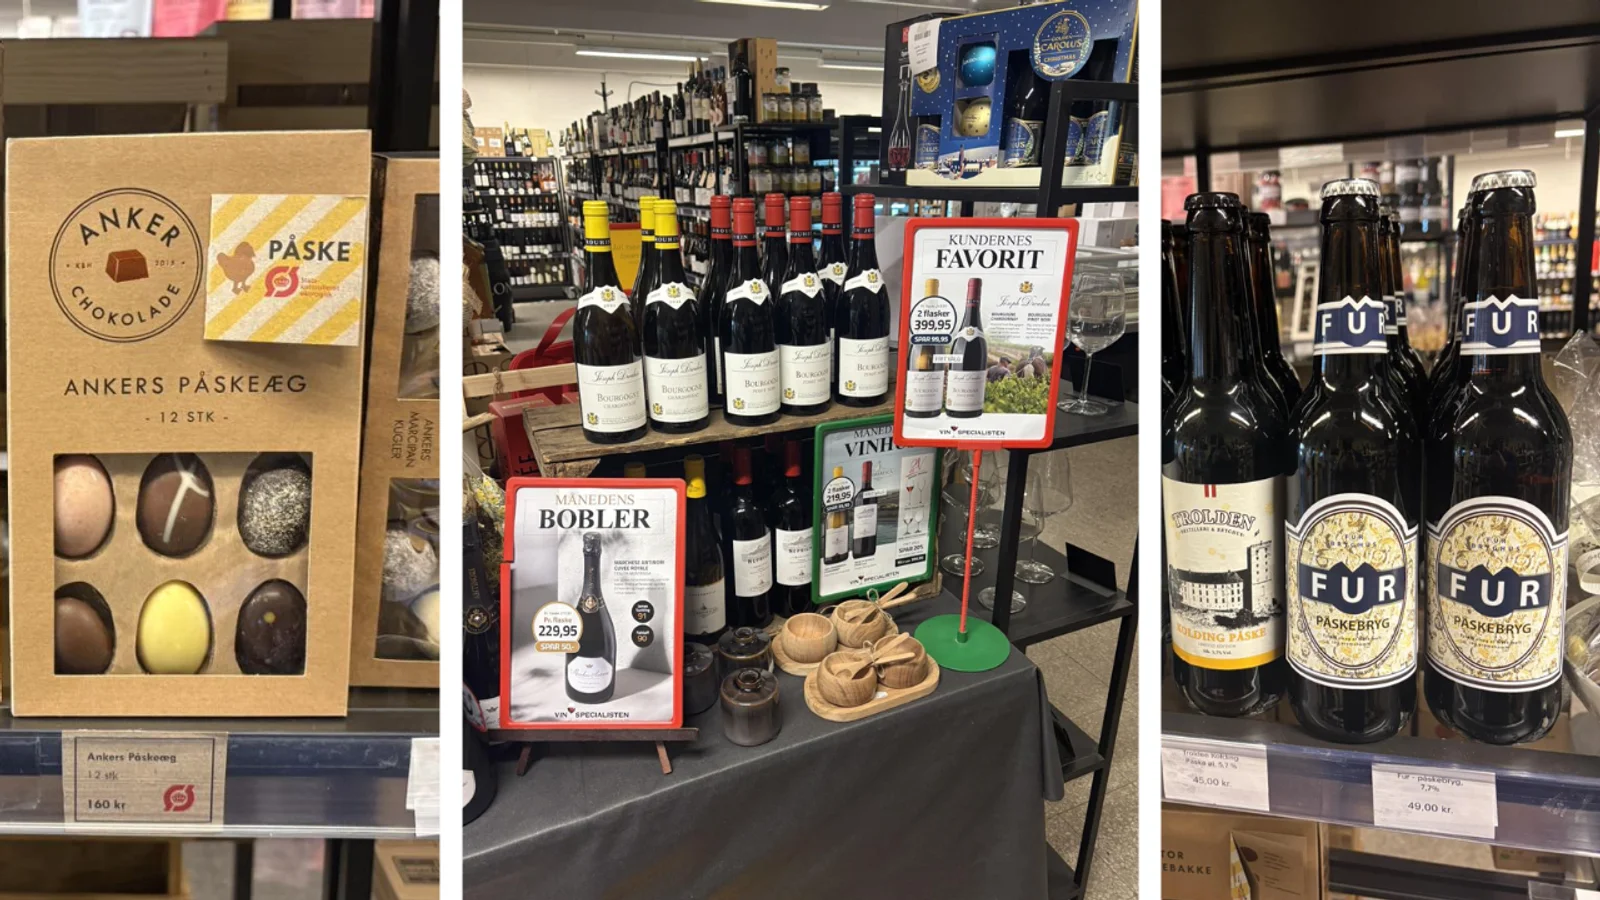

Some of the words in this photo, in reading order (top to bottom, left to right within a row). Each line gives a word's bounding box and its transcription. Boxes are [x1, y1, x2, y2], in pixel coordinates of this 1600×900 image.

[1040, 39, 1083, 52] CAROLUS
[1044, 54, 1076, 63] CHRISTMAS
[79, 207, 180, 247] ANKER
[948, 234, 1032, 246] KUNDERNES
[268, 234, 350, 262] PÅSKE
[935, 248, 1044, 270] FAVORIT
[72, 284, 180, 326] CHOKOLADE
[924, 310, 950, 318] flasker
[914, 320, 951, 332] 399,95
[1322, 312, 1385, 336] FUR
[1466, 310, 1538, 336] FUR
[64, 377, 164, 396] ANKERS
[179, 370, 307, 394] PÅSKEÆG
[160, 412, 178, 423] 12
[186, 412, 215, 422] STK
[958, 428, 1006, 436] SPECIALISTEN
[390, 420, 404, 459] KUGLER
[406, 411, 420, 468] MARCIPAN
[420, 418, 434, 461] ANKERS
[844, 437, 915, 457] VINH
[555, 492, 635, 506] MÅNEDENS
[826, 492, 851, 503] 219,95
[538, 508, 651, 530] BOBLER
[1172, 508, 1256, 531] TROLDEN
[1312, 571, 1396, 604] FUR
[1450, 572, 1540, 608] FUR
[636, 612, 647, 620] 91
[538, 625, 578, 638] 229,95
[1176, 624, 1225, 642] KOLDING
[1229, 626, 1267, 642] PÅSKE
[88, 752, 124, 762] Ankers
[88, 771, 101, 779] 12
[1192, 776, 1220, 786] 45,00
[1420, 784, 1440, 792] 7,7%
[88, 800, 110, 809] 160
[114, 800, 126, 810] kr
[1408, 802, 1438, 812] 49,00
[1441, 806, 1454, 814] kr.
